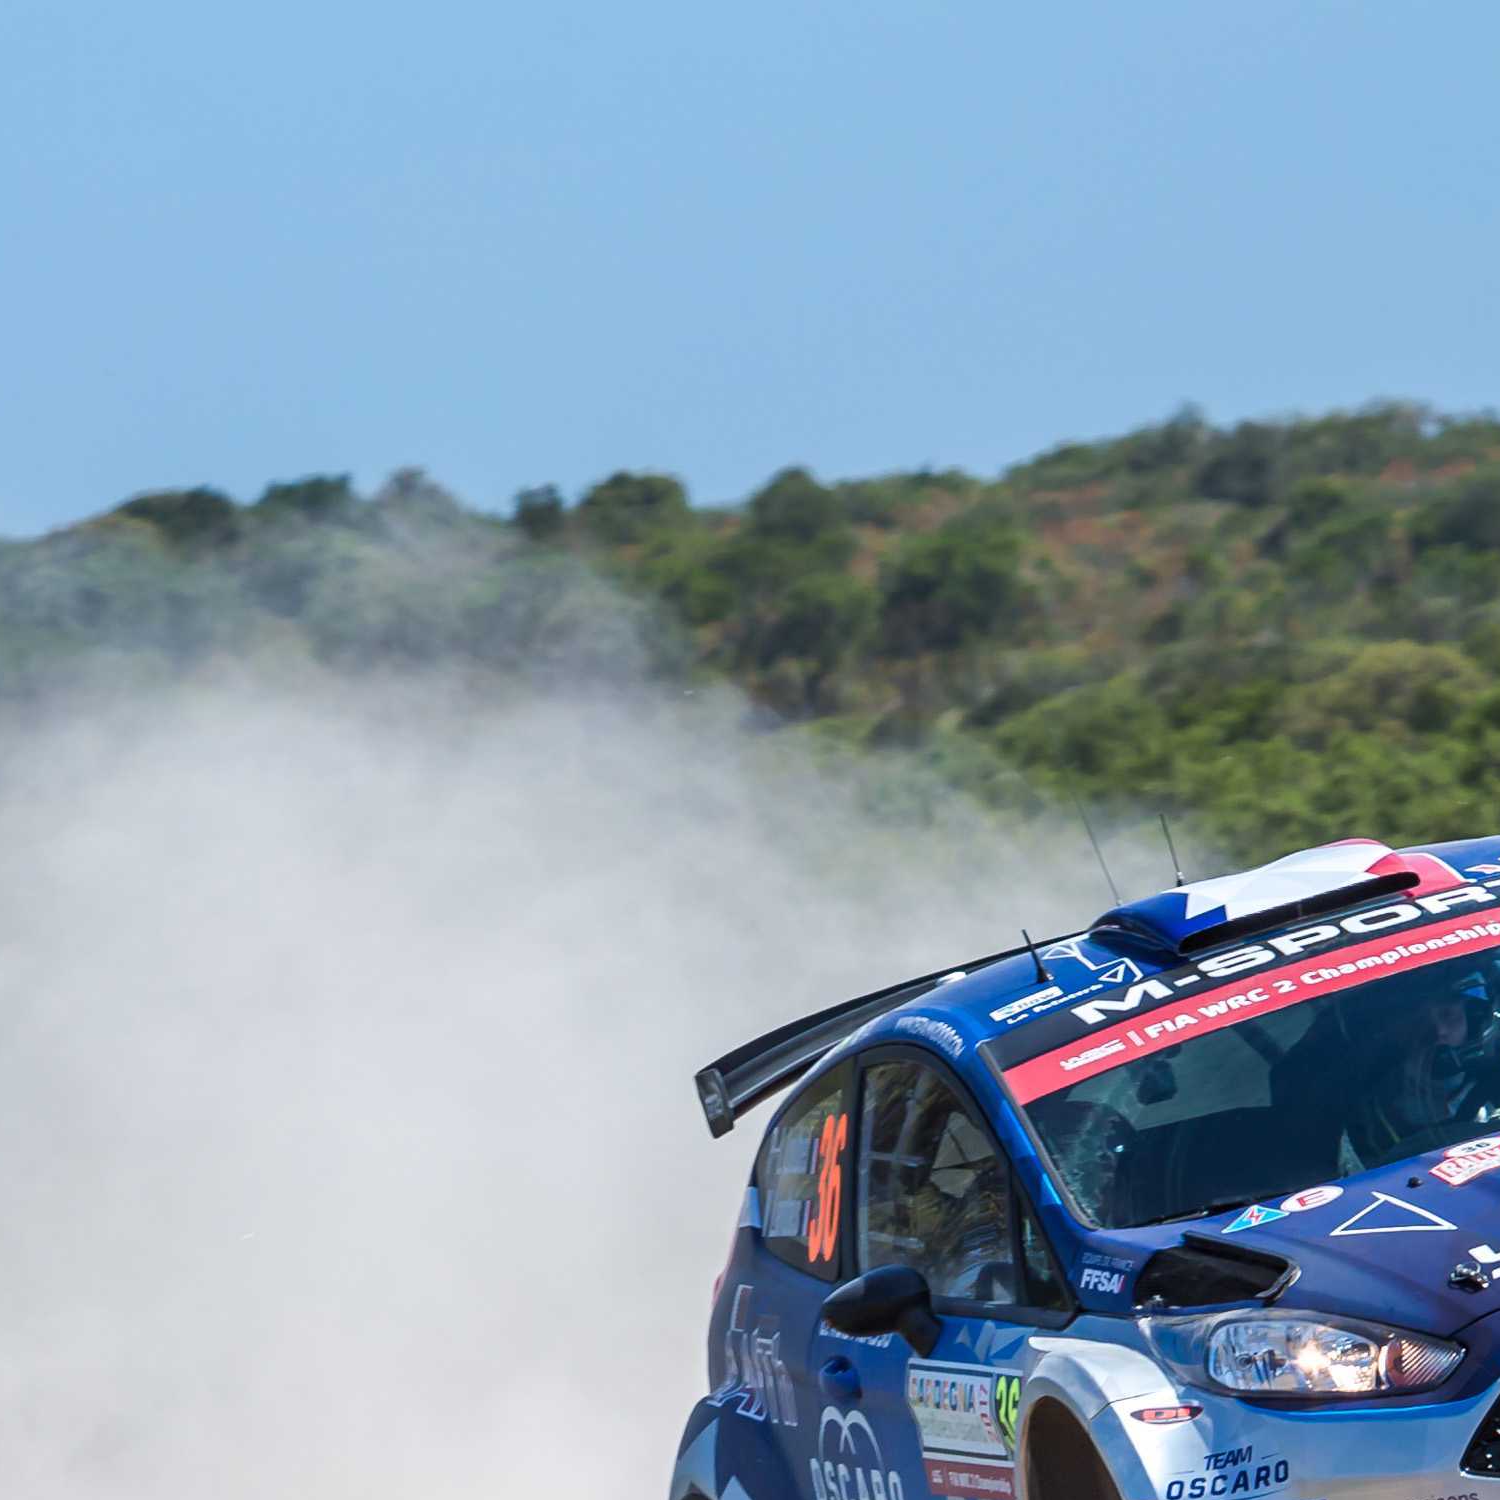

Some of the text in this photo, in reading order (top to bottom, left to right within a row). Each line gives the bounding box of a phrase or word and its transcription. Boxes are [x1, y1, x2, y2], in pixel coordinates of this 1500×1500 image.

[1144, 1013, 1199, 1039] FIA
[1198, 988, 1269, 1019] WRC
[1272, 980, 1298, 994] 2
[1461, 1142, 1491, 1153] 36
[808, 1113, 848, 1263] 36
[1080, 1268, 1120, 1294] FFSA
[1204, 1445, 1253, 1471] TEAM
[1166, 1459, 1289, 1500] OSCARO
